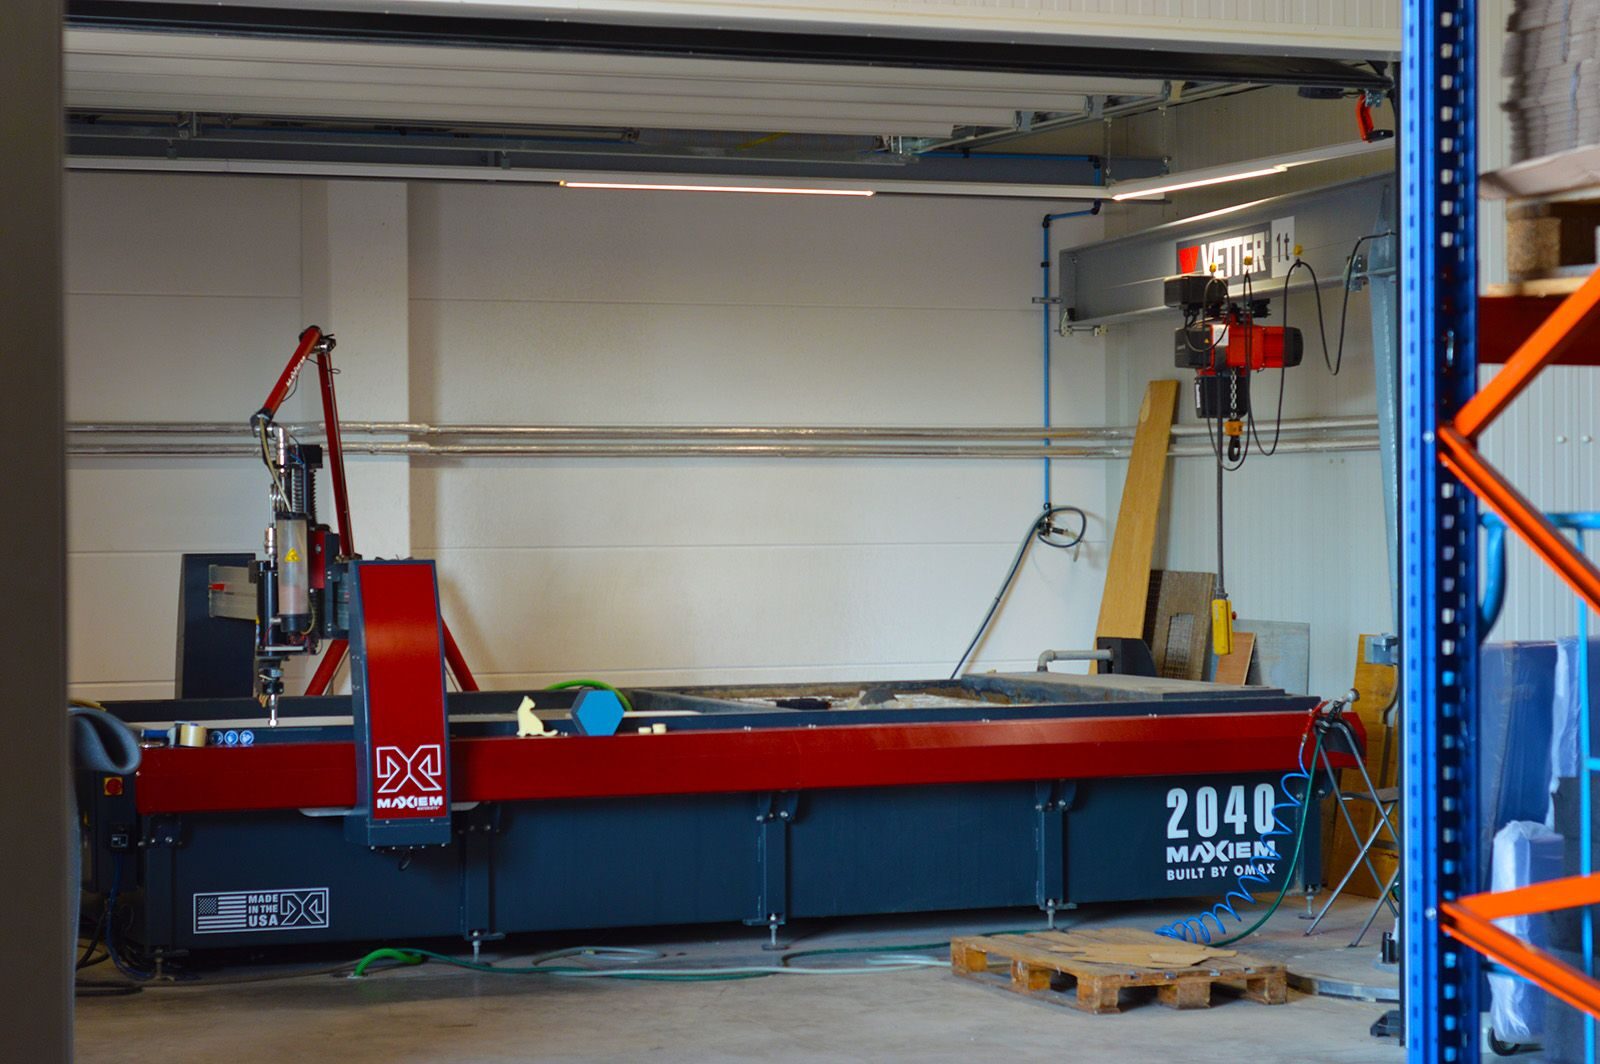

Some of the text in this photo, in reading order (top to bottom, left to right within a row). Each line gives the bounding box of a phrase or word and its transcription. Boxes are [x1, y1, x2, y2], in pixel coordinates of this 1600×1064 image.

[1201, 232, 1266, 278] VETTER
[377, 796, 443, 809] MAXIEM
[1166, 783, 1275, 839] 2040
[1166, 840, 1276, 863] MAXIEM
[1167, 863, 1276, 881] BUILT BY OMAX
[248, 894, 279, 904] MADE
[248, 904, 279, 914] IN THE
[248, 914, 279, 927] USA
